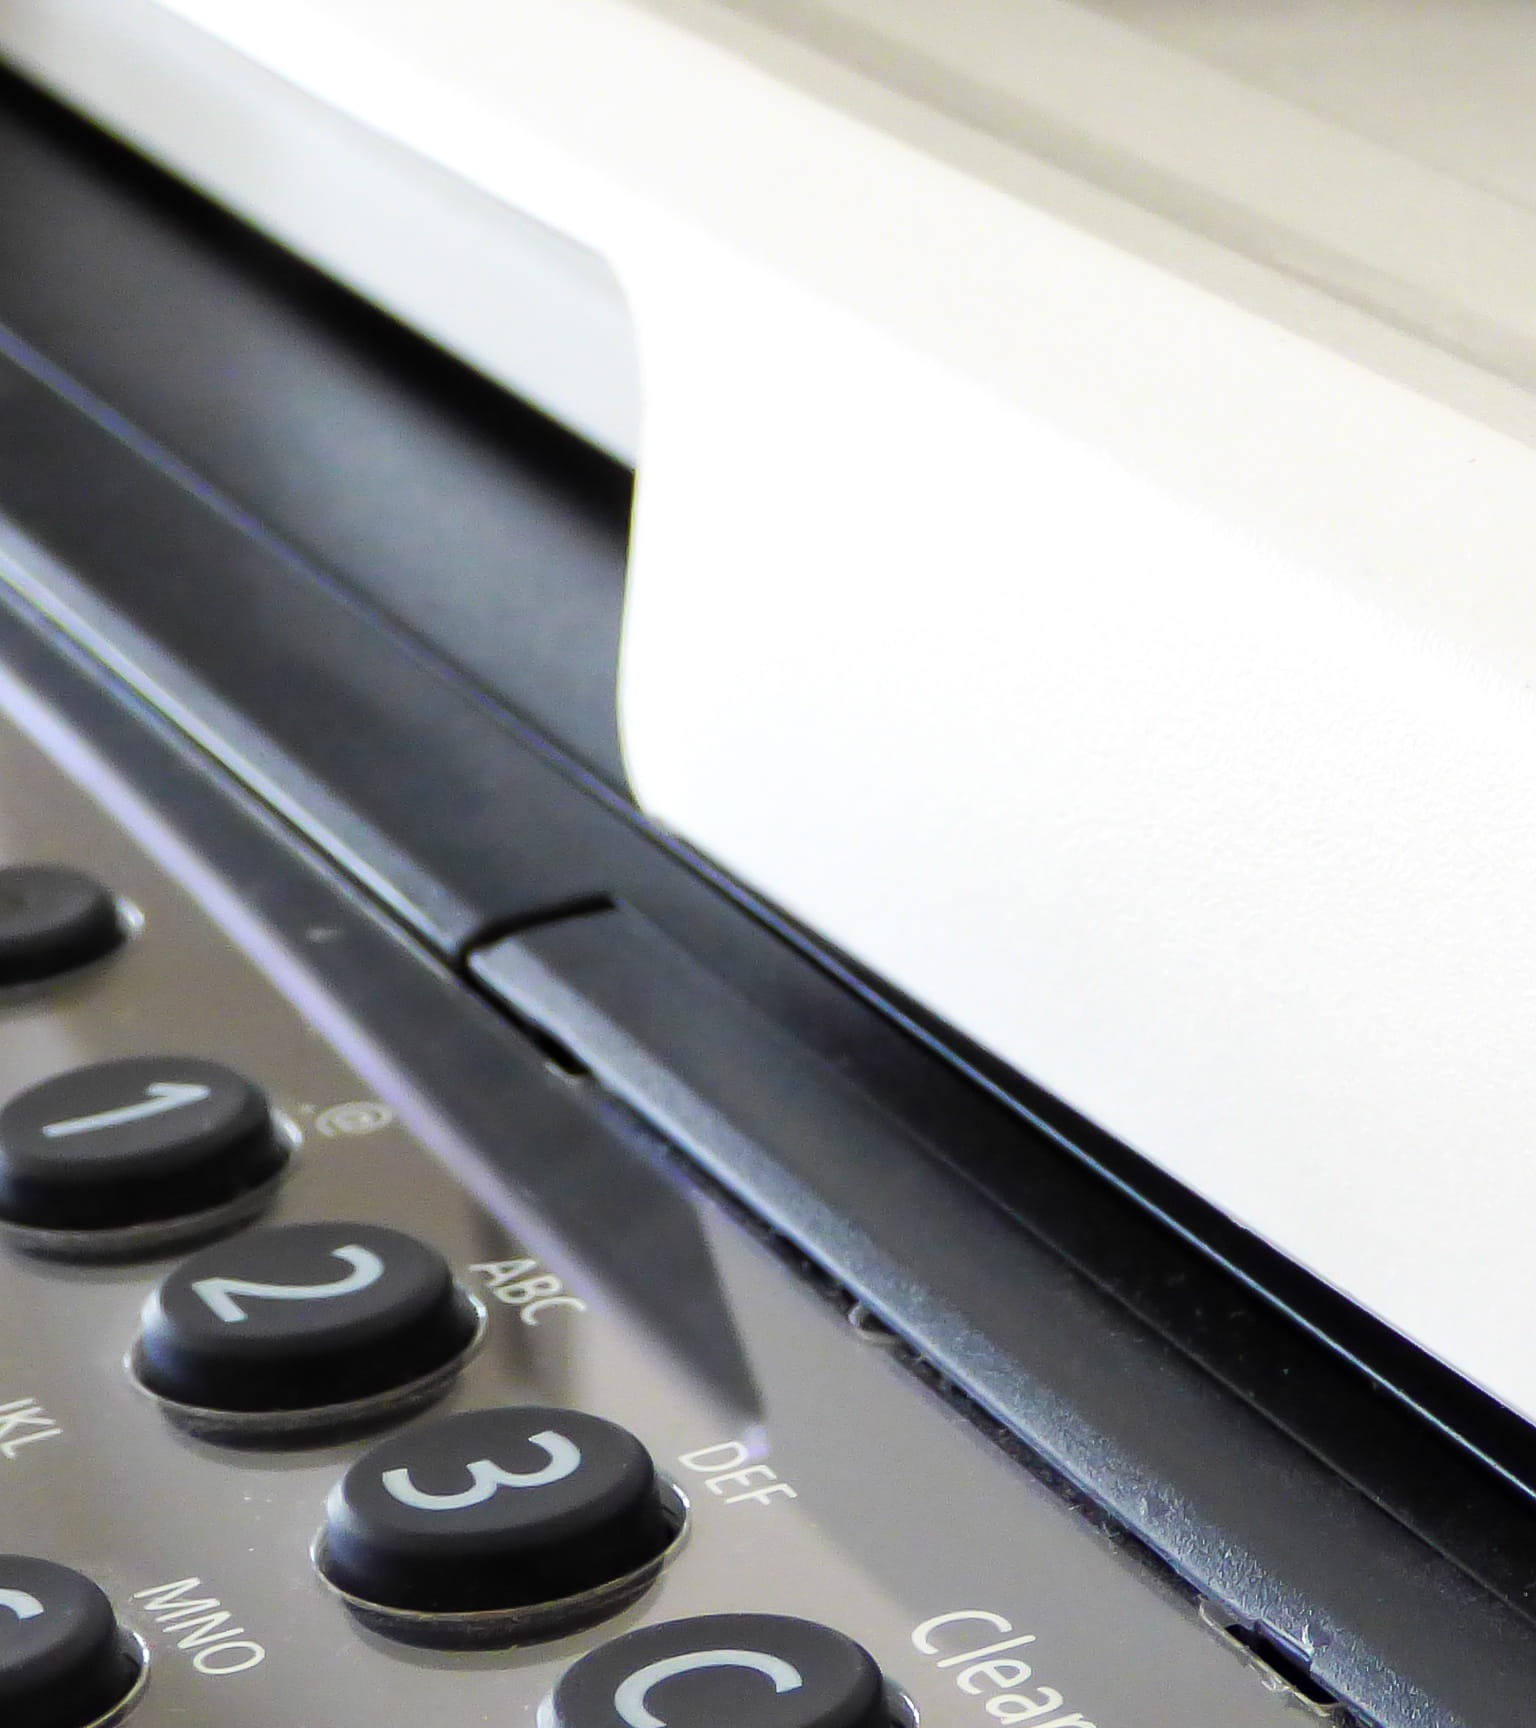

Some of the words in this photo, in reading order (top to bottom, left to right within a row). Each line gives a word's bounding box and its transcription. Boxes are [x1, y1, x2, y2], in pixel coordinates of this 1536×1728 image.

[44, 1081, 210, 1138] 1
[191, 1243, 384, 1323] 2
[468, 1258, 588, 1326] ABC
[382, 1431, 581, 1512] 3
[678, 1439, 796, 1507] DEF
[133, 1577, 266, 1676] MNO
